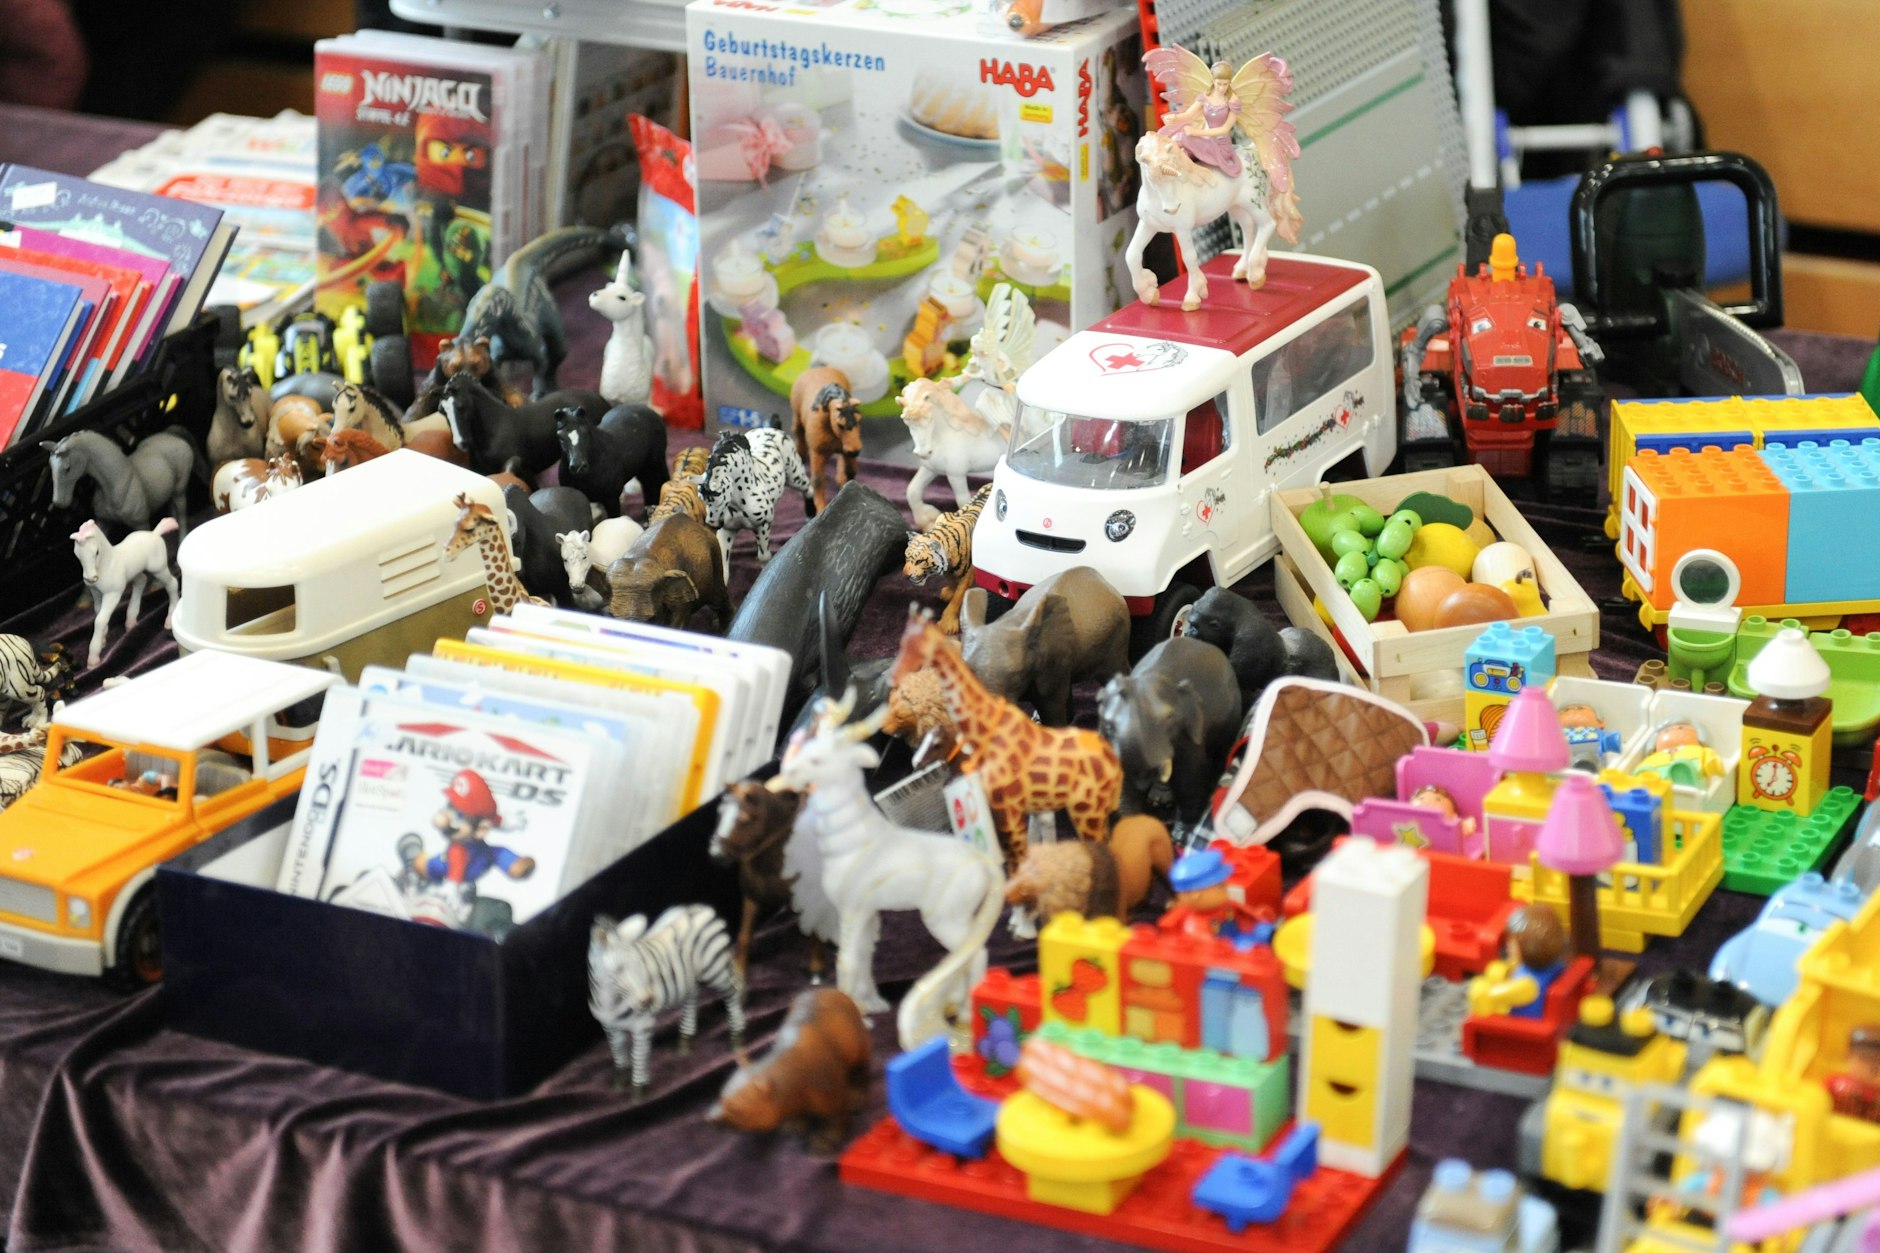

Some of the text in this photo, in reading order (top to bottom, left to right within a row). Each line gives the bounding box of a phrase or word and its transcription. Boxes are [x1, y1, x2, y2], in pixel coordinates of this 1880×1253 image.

[704, 29, 886, 71] Geburtstagskerzen
[705, 55, 796, 87] Bauernhof
[980, 58, 1054, 97] HABA
[358, 70, 490, 123] NINJAGO
[1078, 57, 1092, 137] HABA
[385, 736, 474, 767] ARIO
[312, 761, 337, 811] DS
[511, 781, 568, 807] DS
